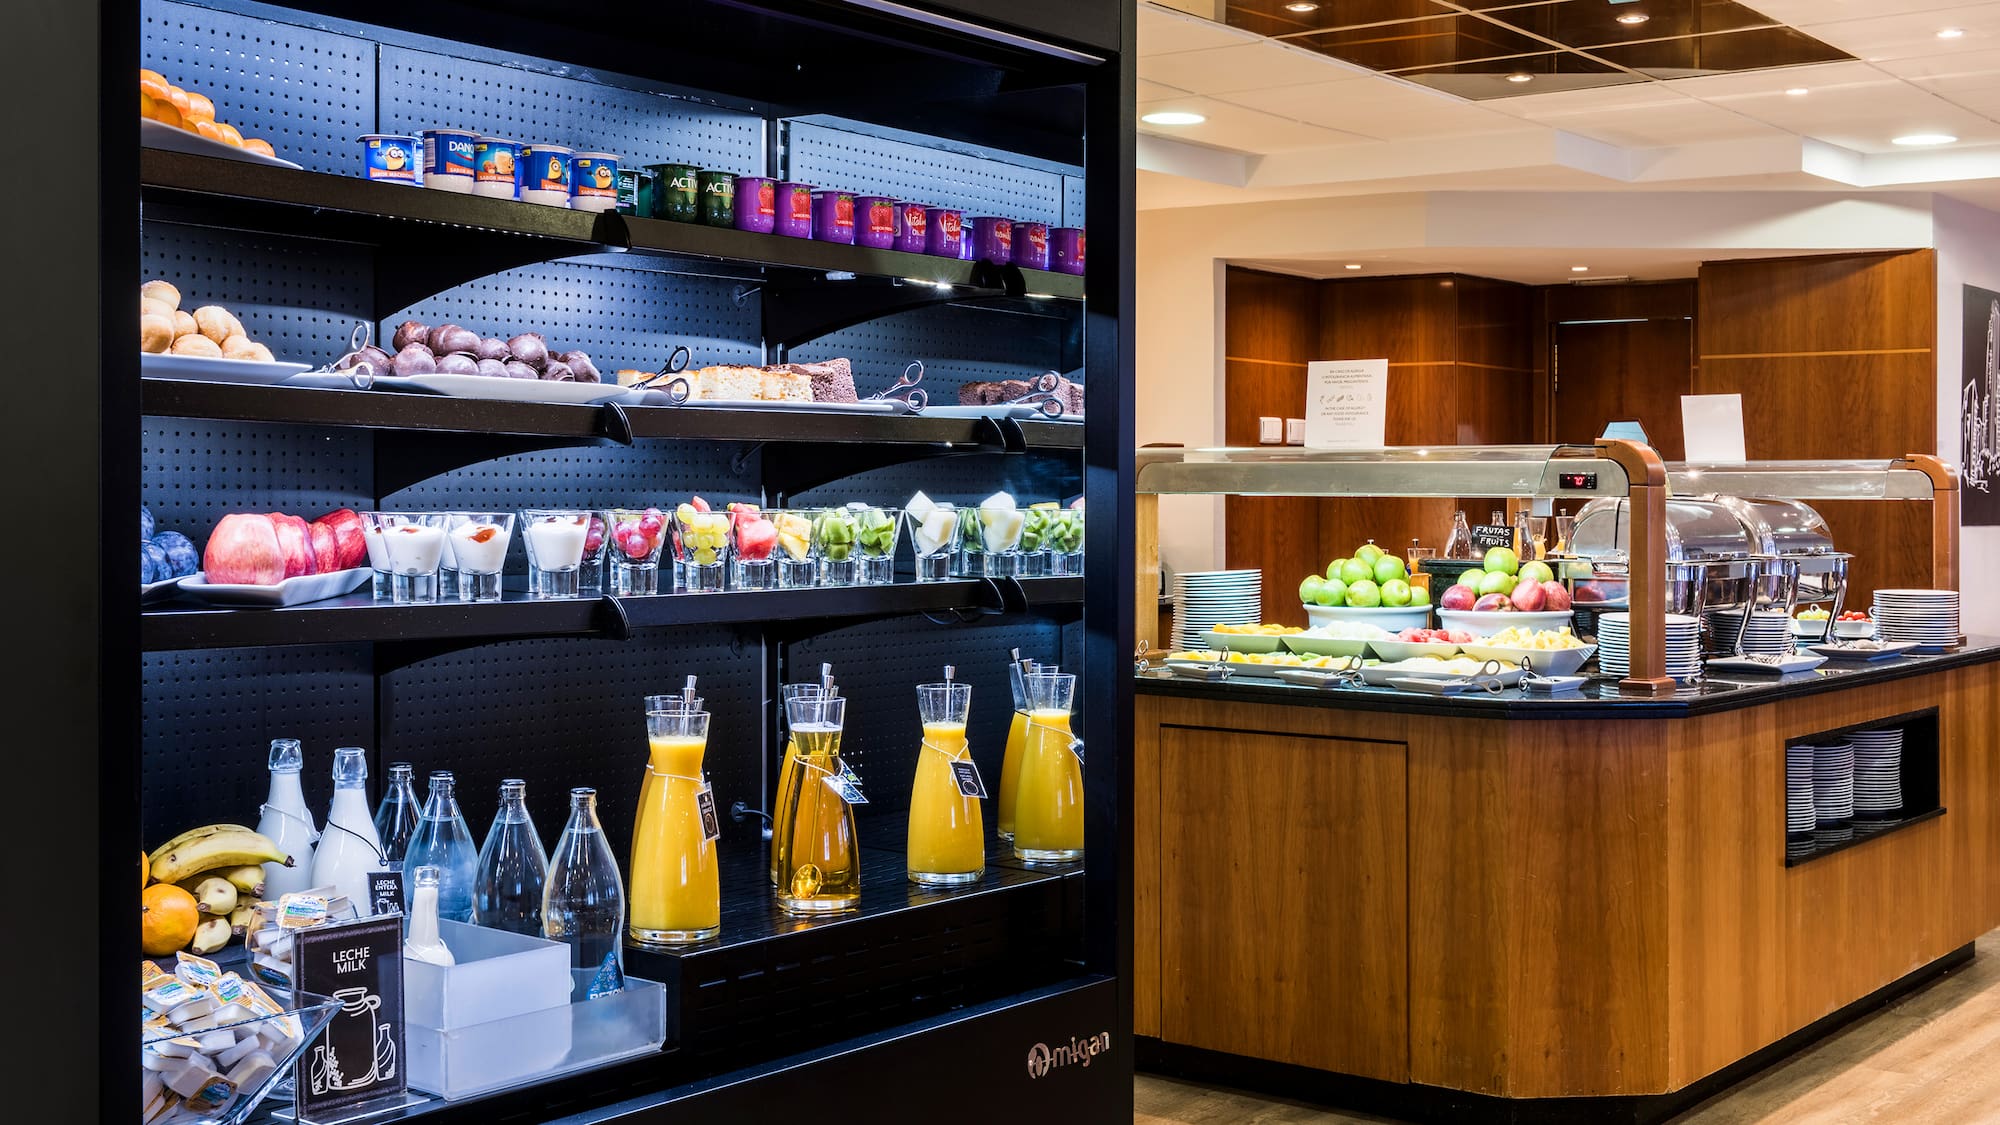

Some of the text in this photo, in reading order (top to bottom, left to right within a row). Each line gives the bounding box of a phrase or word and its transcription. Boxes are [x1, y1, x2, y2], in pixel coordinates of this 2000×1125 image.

[1475, 526, 1510, 536] FRUTAS
[1480, 536, 1510, 547] FRUITS
[332, 946, 370, 963] LECHE
[337, 959, 366, 974] MILK
